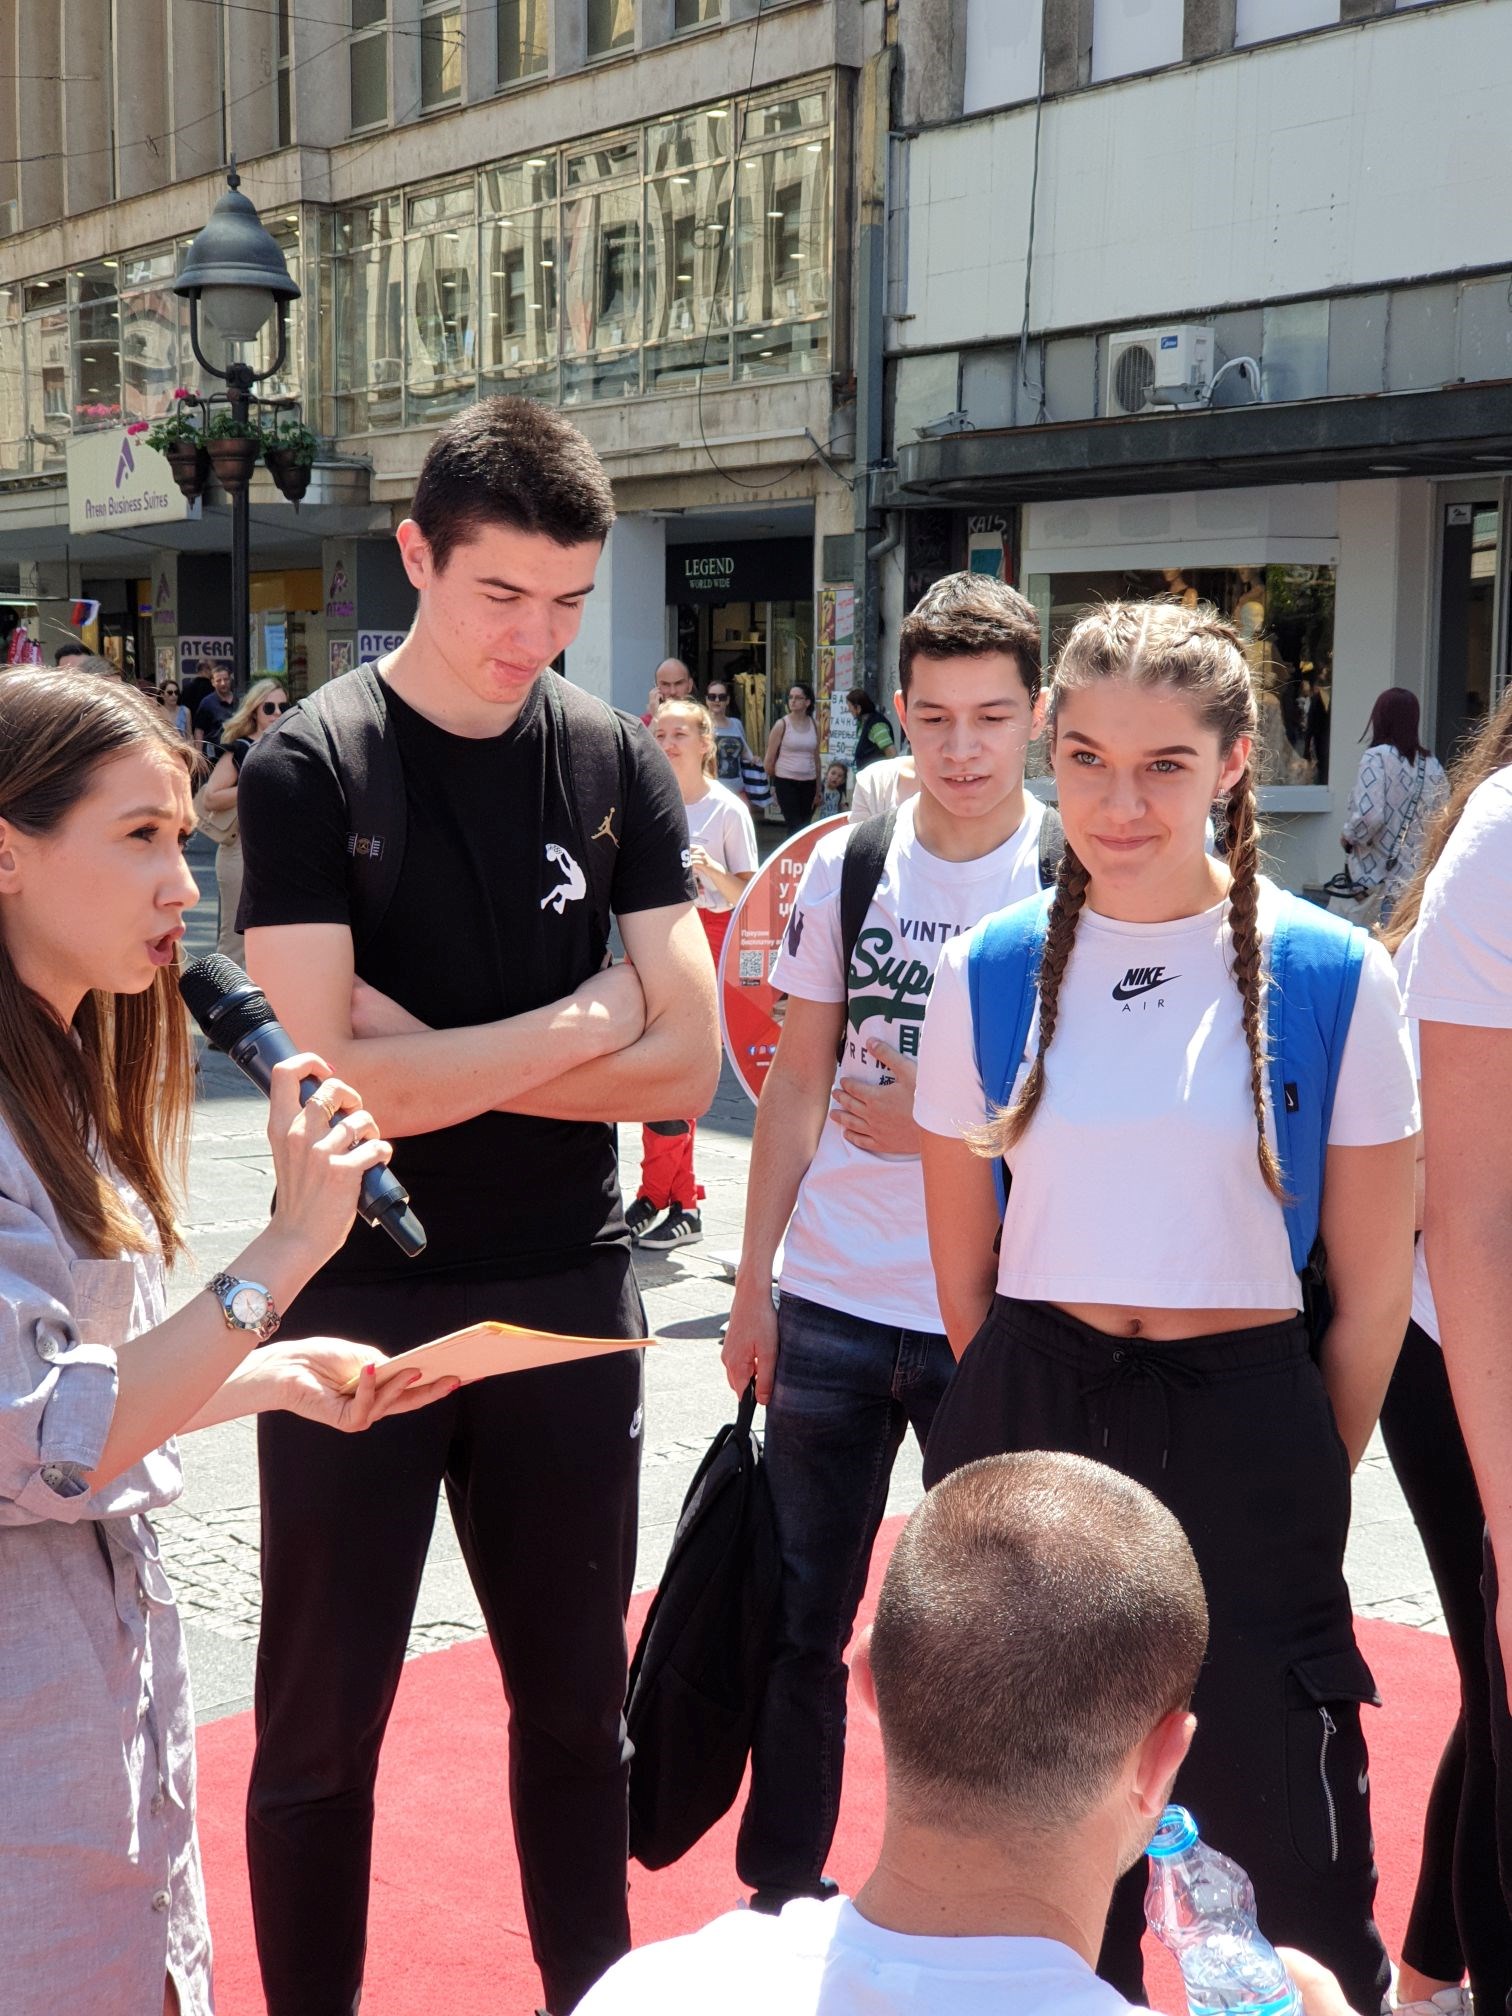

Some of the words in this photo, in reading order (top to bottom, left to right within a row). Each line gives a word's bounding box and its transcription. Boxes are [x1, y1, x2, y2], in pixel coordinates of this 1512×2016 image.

[685, 557, 735, 576] LEGEND
[181, 641, 234, 656] ATERA
[780, 858, 807, 878] Пр
[900, 918, 972, 944] VINTA
[1122, 966, 1166, 987] NIKE
[1121, 998, 1165, 1012] AIR
